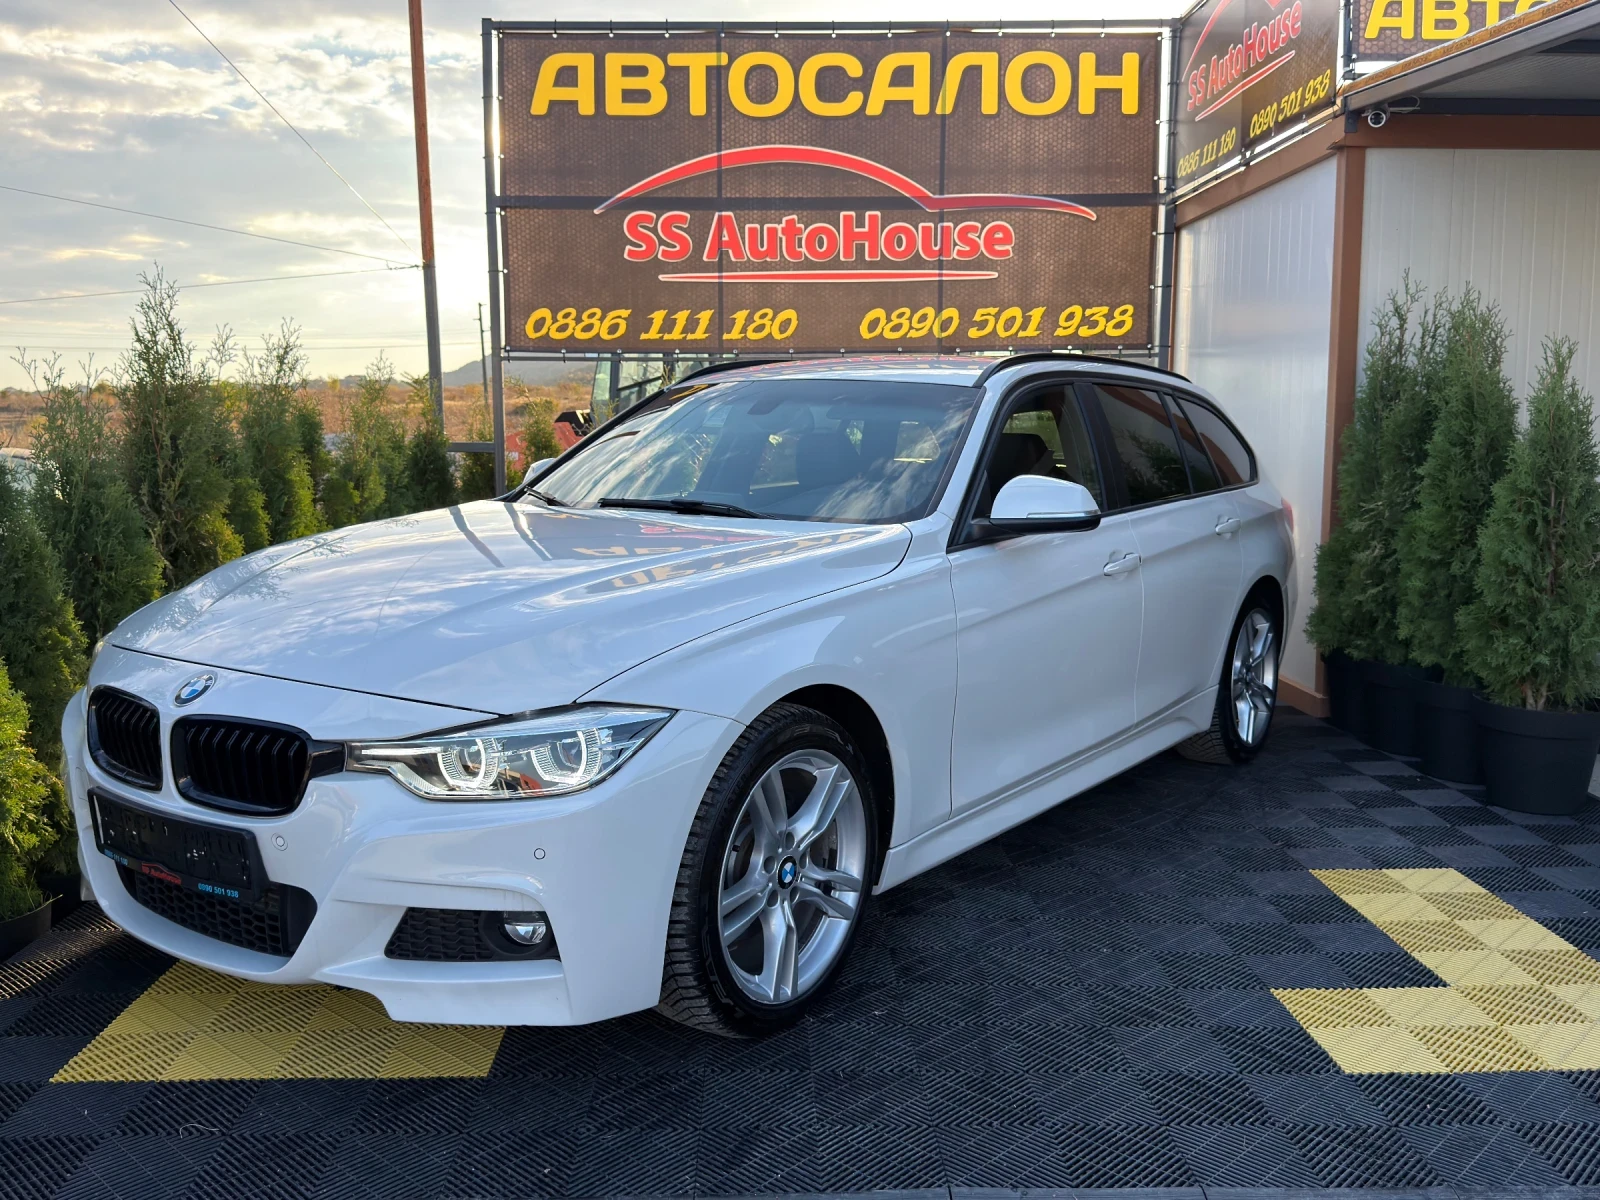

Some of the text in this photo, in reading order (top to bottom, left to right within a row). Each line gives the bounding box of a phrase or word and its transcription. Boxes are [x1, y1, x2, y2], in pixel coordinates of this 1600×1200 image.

[1364, 0, 1550, 40] АВТ
[1187, 0, 1302, 111] SS AutoHouse
[529, 50, 1141, 117] АВТОСАЛОН
[1250, 102, 1278, 139] 0890
[1278, 87, 1303, 122] 501
[1303, 69, 1331, 108] 938
[1177, 127, 1236, 178] 0886 111 180
[624, 211, 1015, 262] SS AutoHouse
[525, 307, 799, 341] 0886 111 180
[859, 304, 1135, 340] 0890 501 938
[214, 886, 225, 896] 501
[226, 889, 239, 899] 938
